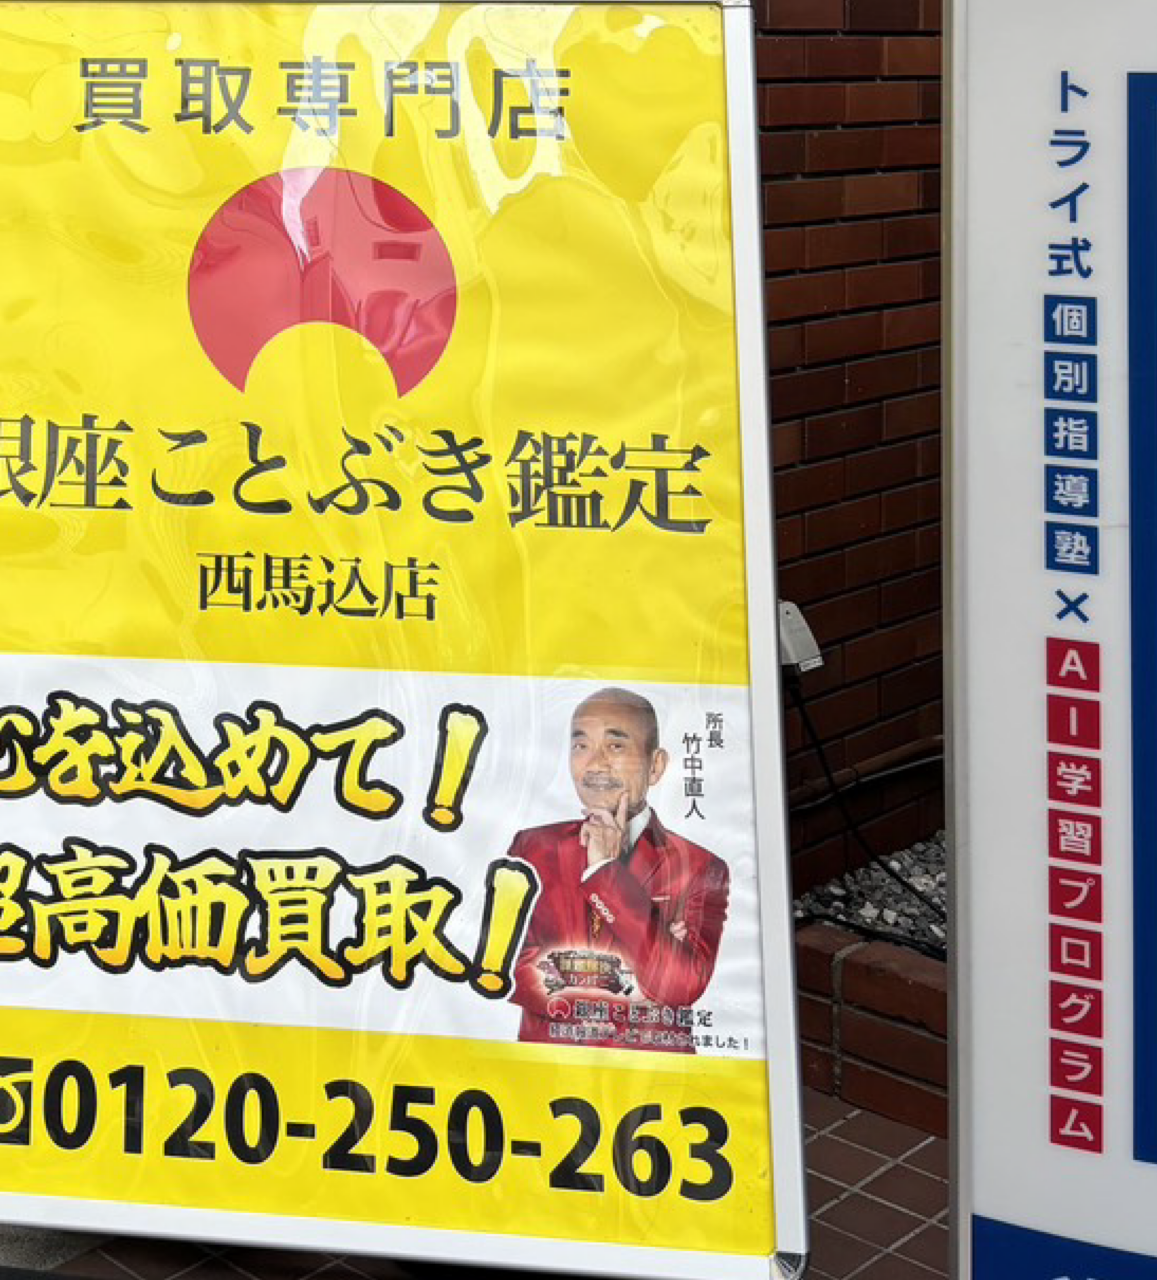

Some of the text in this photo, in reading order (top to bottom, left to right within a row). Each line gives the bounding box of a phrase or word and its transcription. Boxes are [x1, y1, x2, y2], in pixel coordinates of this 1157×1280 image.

[74, 55, 571, 140] 買取専門店
[196, 552, 442, 622] 西馬込店
[705, 712, 724, 748] 所長
[682, 732, 706, 819] 竹中直人
[42, 1058, 735, 1202] 0120-250-263
